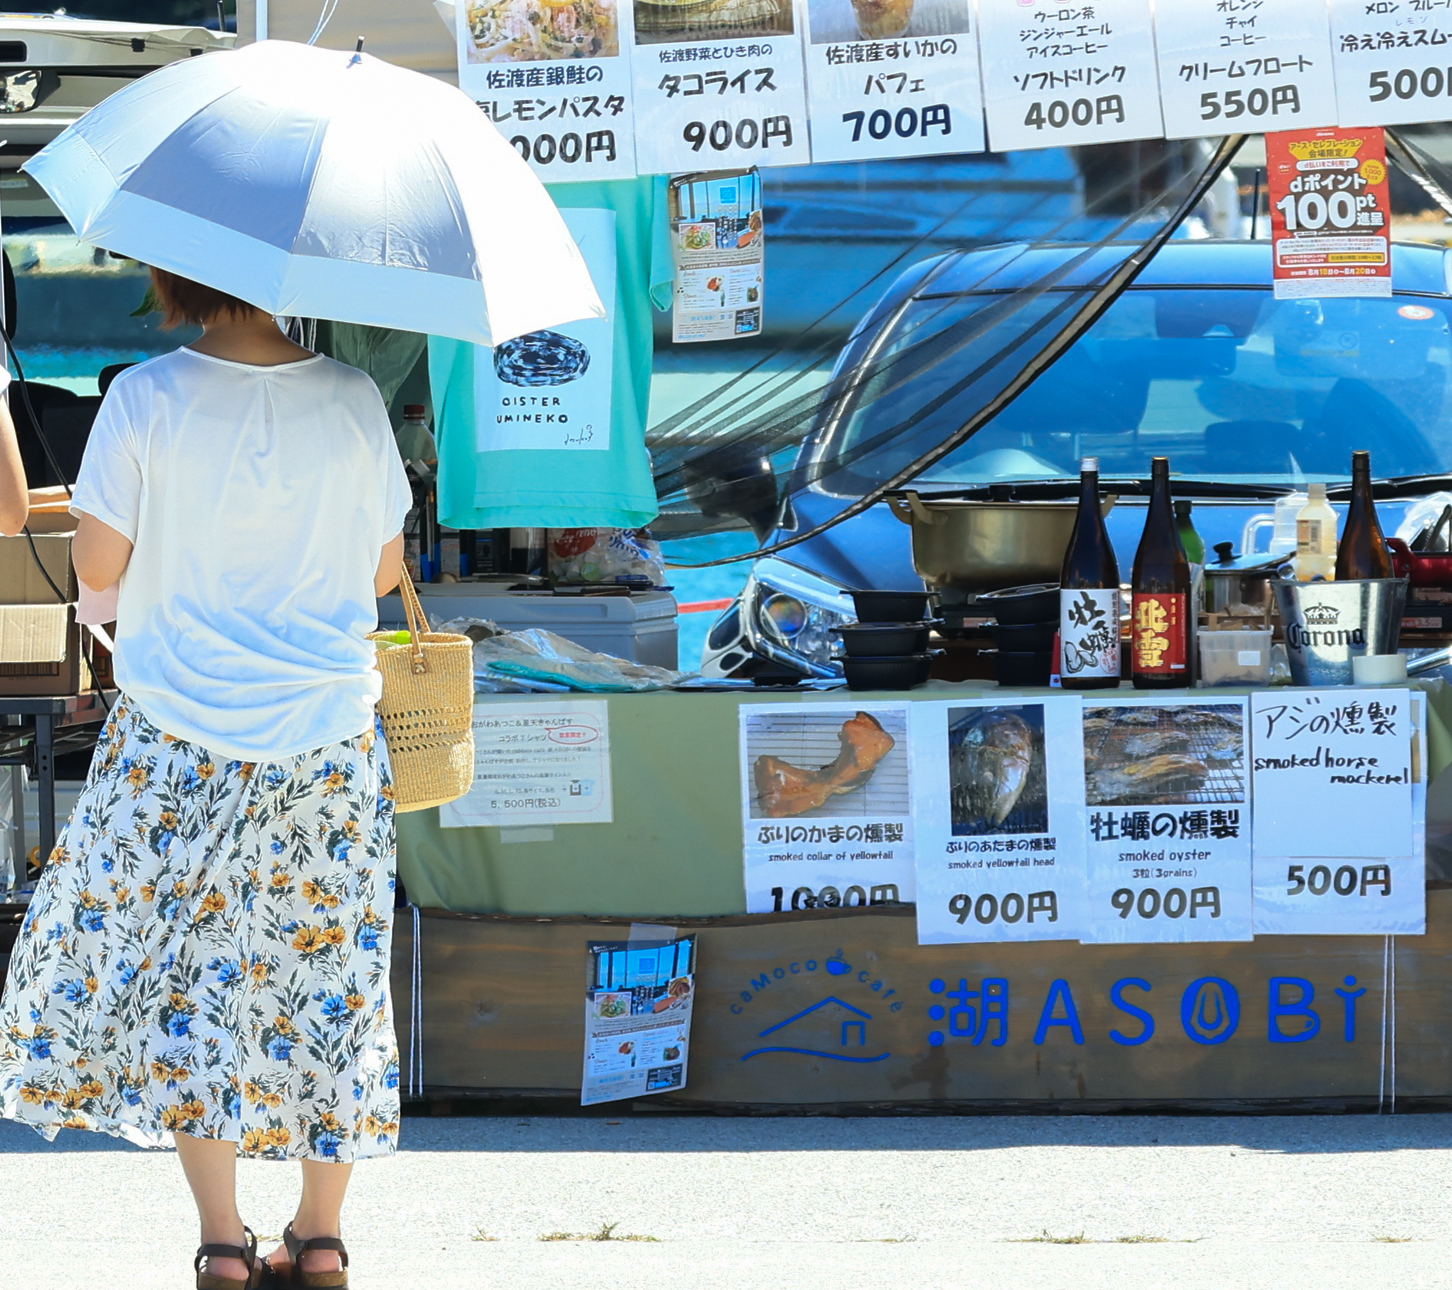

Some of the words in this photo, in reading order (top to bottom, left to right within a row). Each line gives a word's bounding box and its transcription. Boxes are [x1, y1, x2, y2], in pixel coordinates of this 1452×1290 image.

[1034, 7, 1095, 21] ウーロン茶
[1365, 2, 1399, 15] メロン
[1019, 23, 1112, 42] ジンジャーエール
[1225, 15, 1257, 29] チャイ
[826, 38, 957, 65] 佐渡産すいかの
[1026, 43, 1108, 58] アイスコーヒー
[1220, 35, 1266, 47] コーヒー
[659, 44, 773, 63] 佐渡野菜とひき肉の
[486, 65, 603, 89] 佐渡産銀鮭の
[1013, 65, 1126, 91] ソフトドリンク
[1179, 54, 1313, 82] クリームフロート
[658, 67, 777, 98] タコライス
[864, 72, 925, 95] パフェ
[1024, 94, 1126, 130] 400円
[1201, 84, 1301, 120] 550円
[683, 115, 793, 152] 900円
[842, 103, 952, 142] 700円
[1289, 173, 1367, 193] dポイント
[1276, 191, 1358, 230] 100
[1356, 193, 1377, 211] pt
[1356, 212, 1385, 226] 進呈
[502, 396, 561, 406] OISTER
[496, 414, 569, 423] UMINEKO
[1287, 626, 1366, 651] Corona
[1255, 696, 1397, 740] アジの燻製
[1254, 746, 1322, 771] smoked
[1325, 748, 1379, 769] horse
[1330, 767, 1409, 784] mackerel
[757, 823, 903, 844] ぶりのかまの燻製
[1090, 809, 1240, 841] 牡蠣の燻製
[769, 852, 803, 862] smoked
[806, 851, 832, 861] collar
[835, 851, 845, 860] of
[850, 850, 894, 862] yellowtail
[946, 838, 1057, 854] ぶりのあたまの燻製
[1118, 850, 1165, 861] smoked
[1169, 849, 1211, 863] oyster
[948, 861, 983, 869] smoked
[987, 858, 1030, 869] yellowtail
[1033, 857, 1055, 866] head
[1287, 865, 1391, 896] 500円
[948, 890, 1058, 925] 900円
[1111, 886, 1221, 919] 900円
